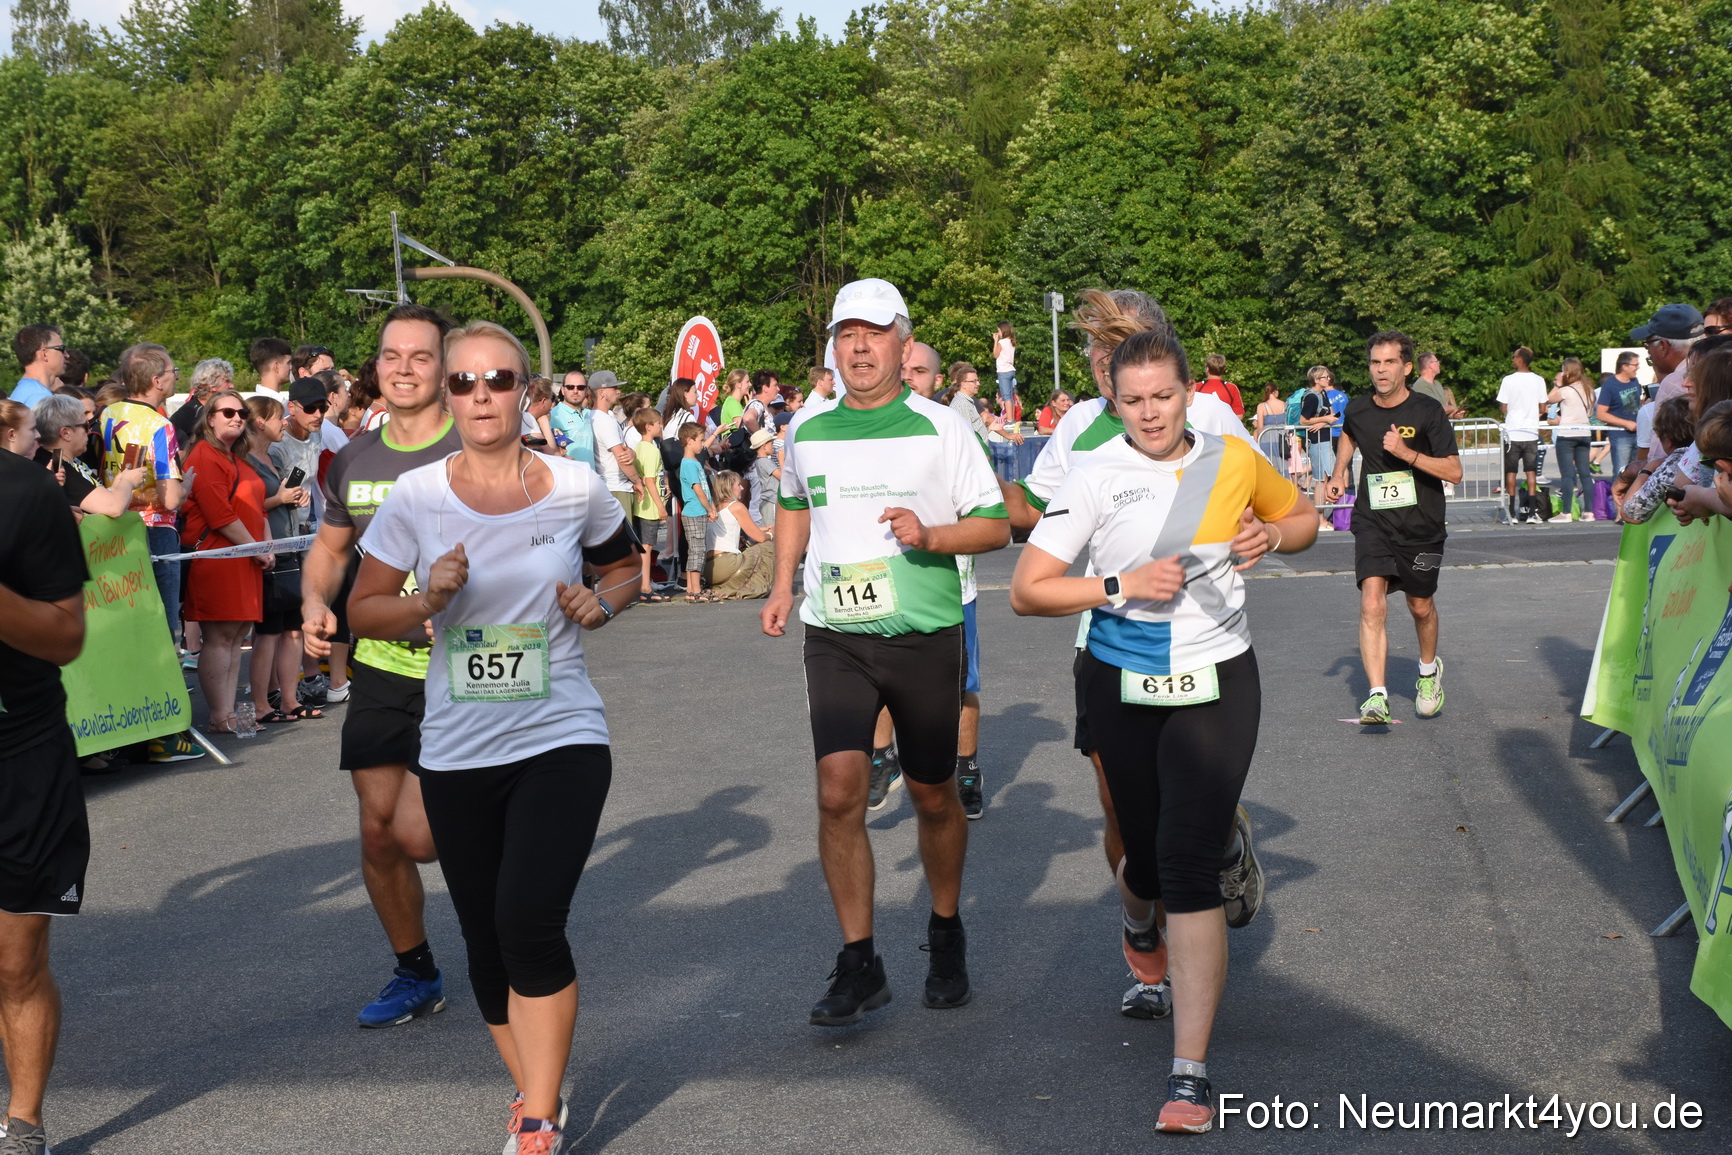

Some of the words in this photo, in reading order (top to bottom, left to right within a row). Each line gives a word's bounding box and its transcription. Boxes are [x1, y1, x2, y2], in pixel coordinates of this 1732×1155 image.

[870, 491, 886, 499] gutes
[887, 490, 918, 498] Baugefühl
[1114, 494, 1143, 508] GROUP
[1381, 486, 1398, 498] 73
[530, 534, 555, 546] Julia
[87, 536, 128, 569] Firmen
[96, 558, 149, 607] länger!
[834, 582, 877, 606] 114
[468, 652, 524, 680] 657
[1143, 675, 1195, 693] 618
